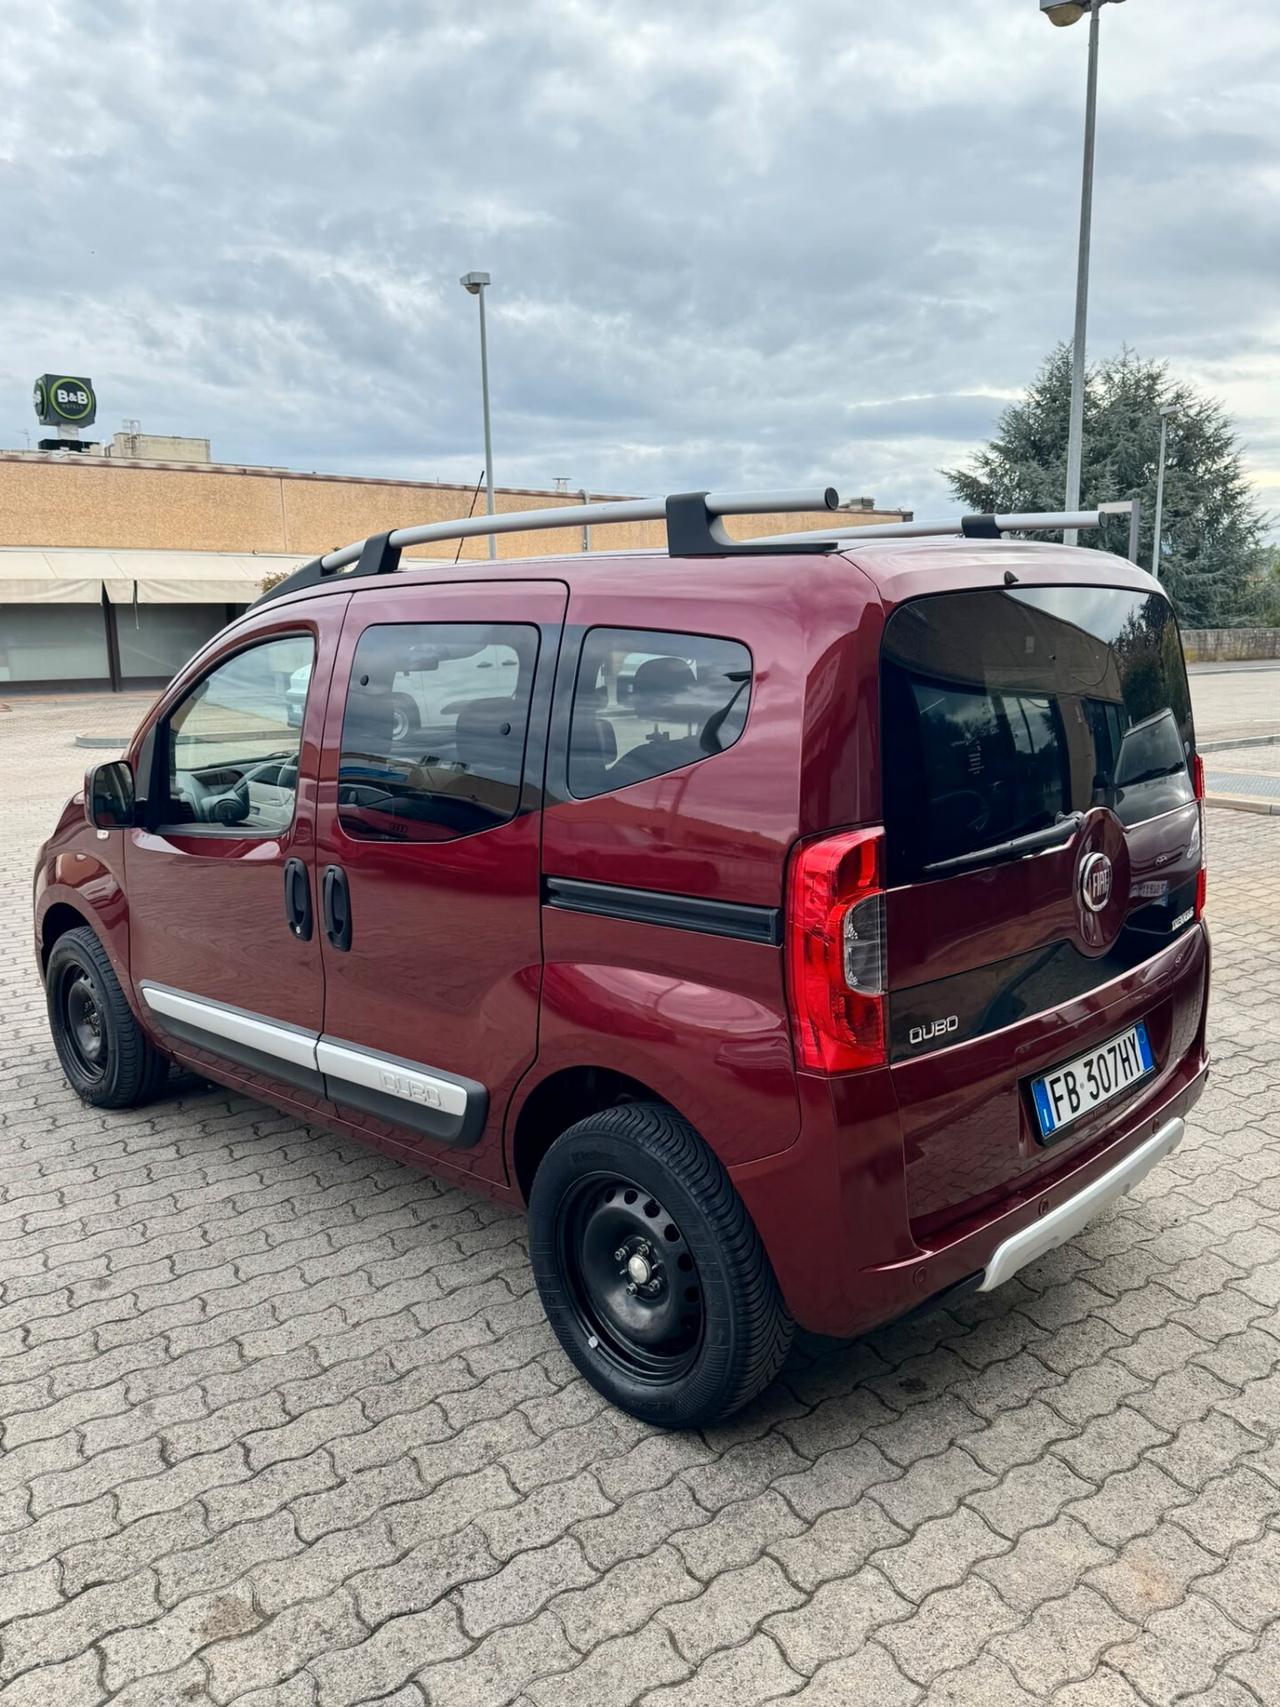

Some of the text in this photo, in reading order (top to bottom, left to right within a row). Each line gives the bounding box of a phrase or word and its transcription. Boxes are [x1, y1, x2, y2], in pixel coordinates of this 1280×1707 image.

[57, 389, 88, 404] B&B
[1092, 869, 1110, 898] FIAT
[909, 1015, 958, 1044] QUBO
[1049, 1033, 1141, 1122] FB 307HY
